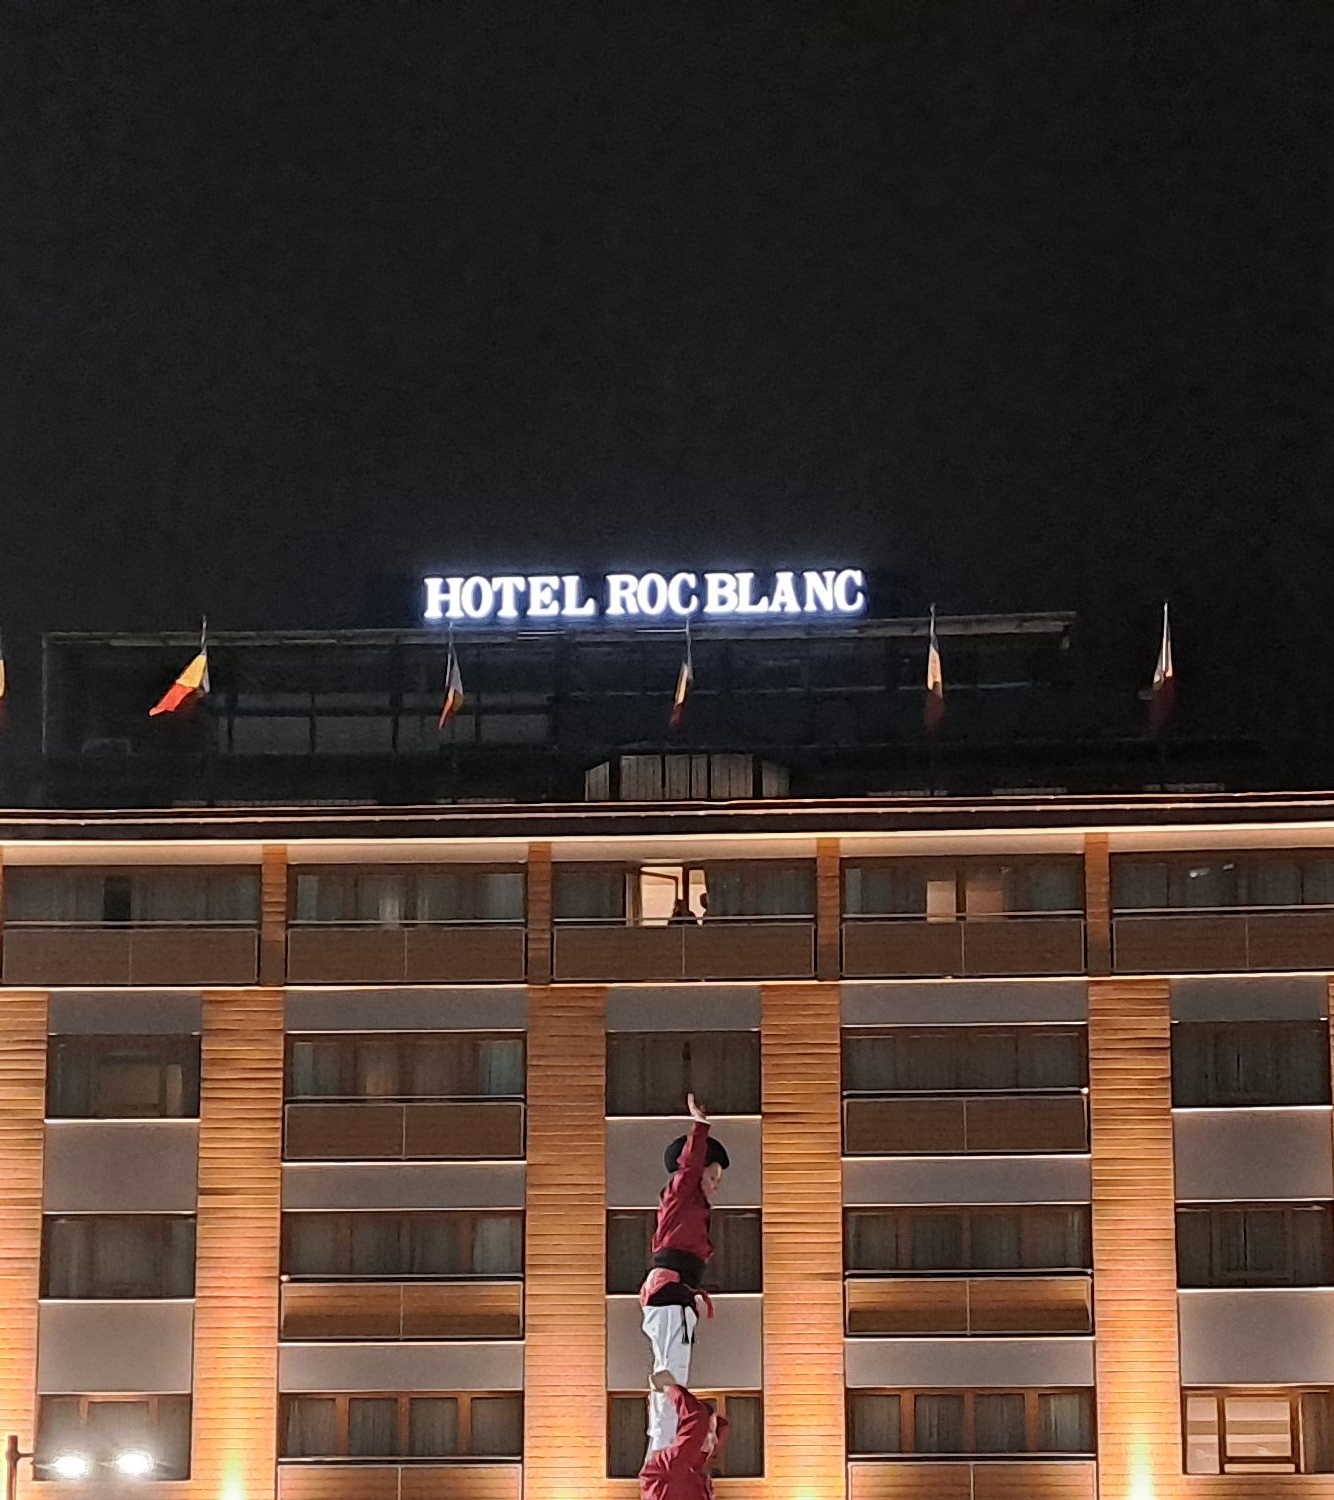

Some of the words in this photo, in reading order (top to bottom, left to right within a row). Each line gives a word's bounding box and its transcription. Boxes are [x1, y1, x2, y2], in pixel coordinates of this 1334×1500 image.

[423, 575, 596, 620] HOTEL
[605, 572, 699, 617] ROC
[703, 569, 865, 615] BLANC
